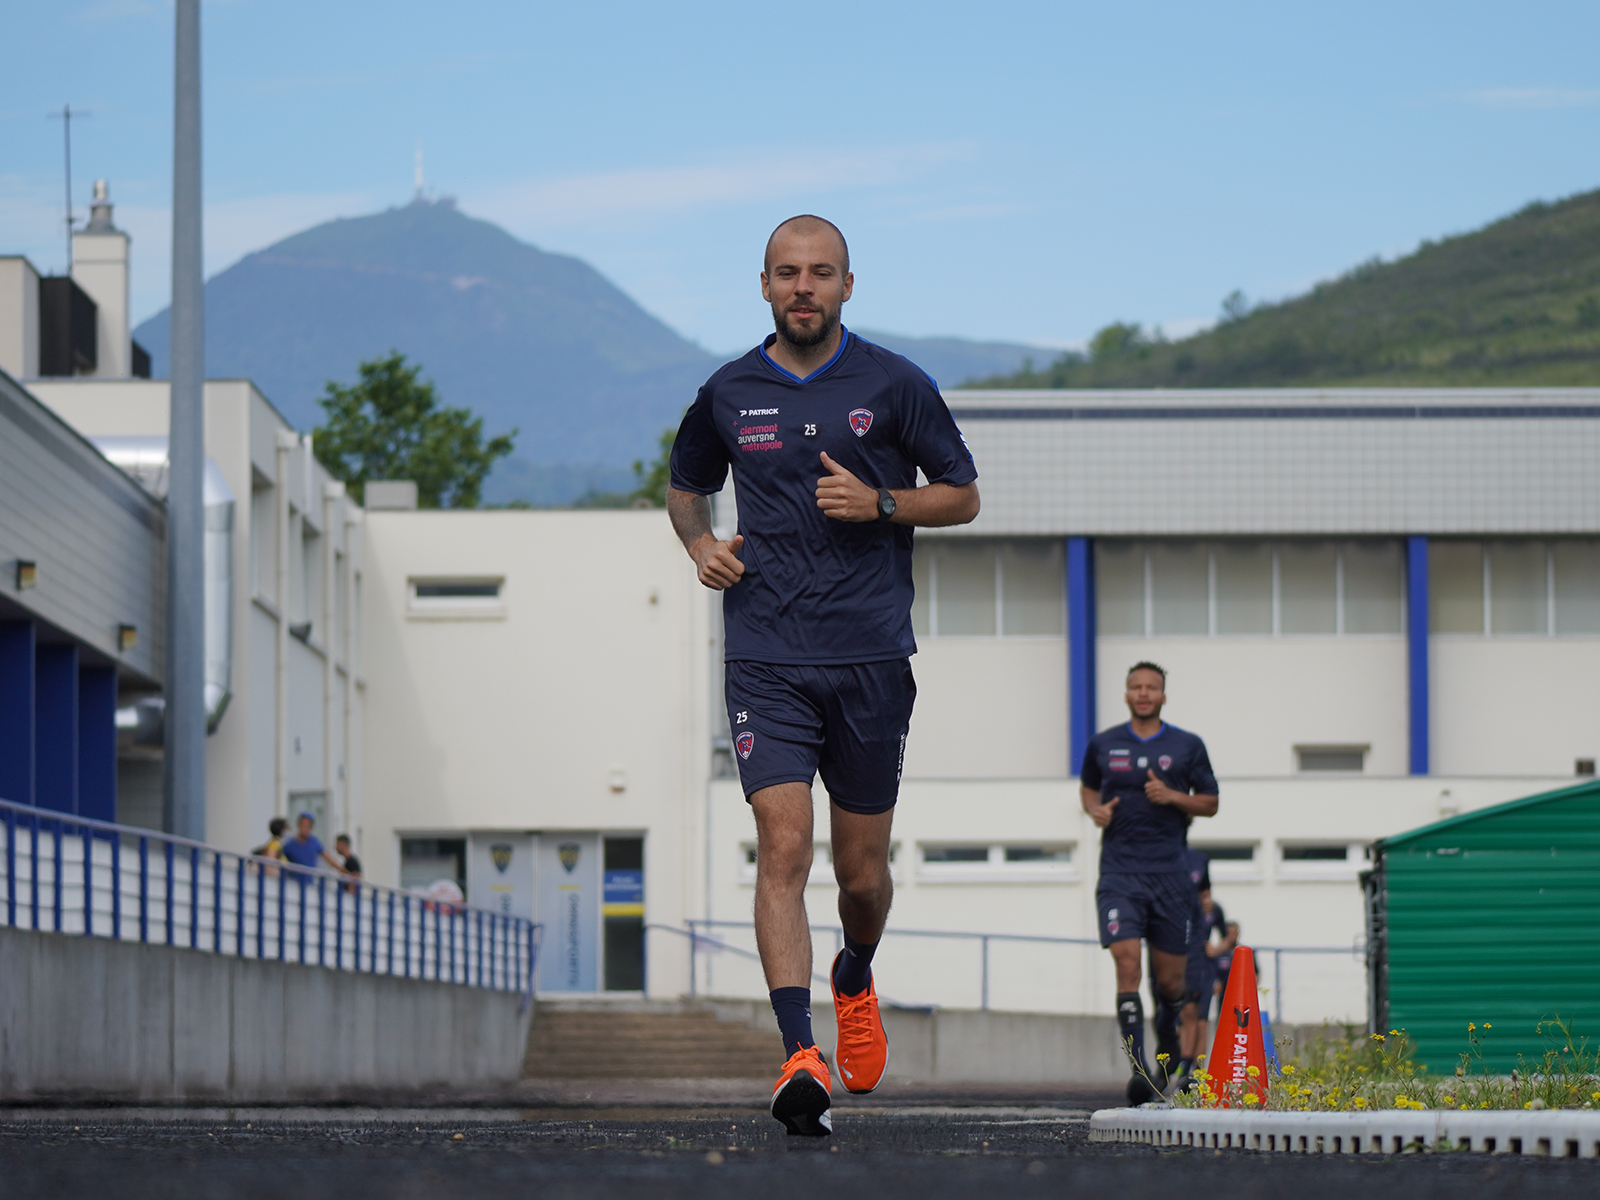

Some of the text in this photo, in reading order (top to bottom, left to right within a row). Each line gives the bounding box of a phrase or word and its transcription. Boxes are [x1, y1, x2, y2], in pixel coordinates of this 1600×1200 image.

[748, 408, 779, 416] PATRICK
[740, 423, 778, 435] clermont
[804, 424, 816, 436] 25
[738, 432, 775, 444] auvergne
[736, 711, 748, 724] 25
[1232, 1033, 1248, 1105] PATRI
